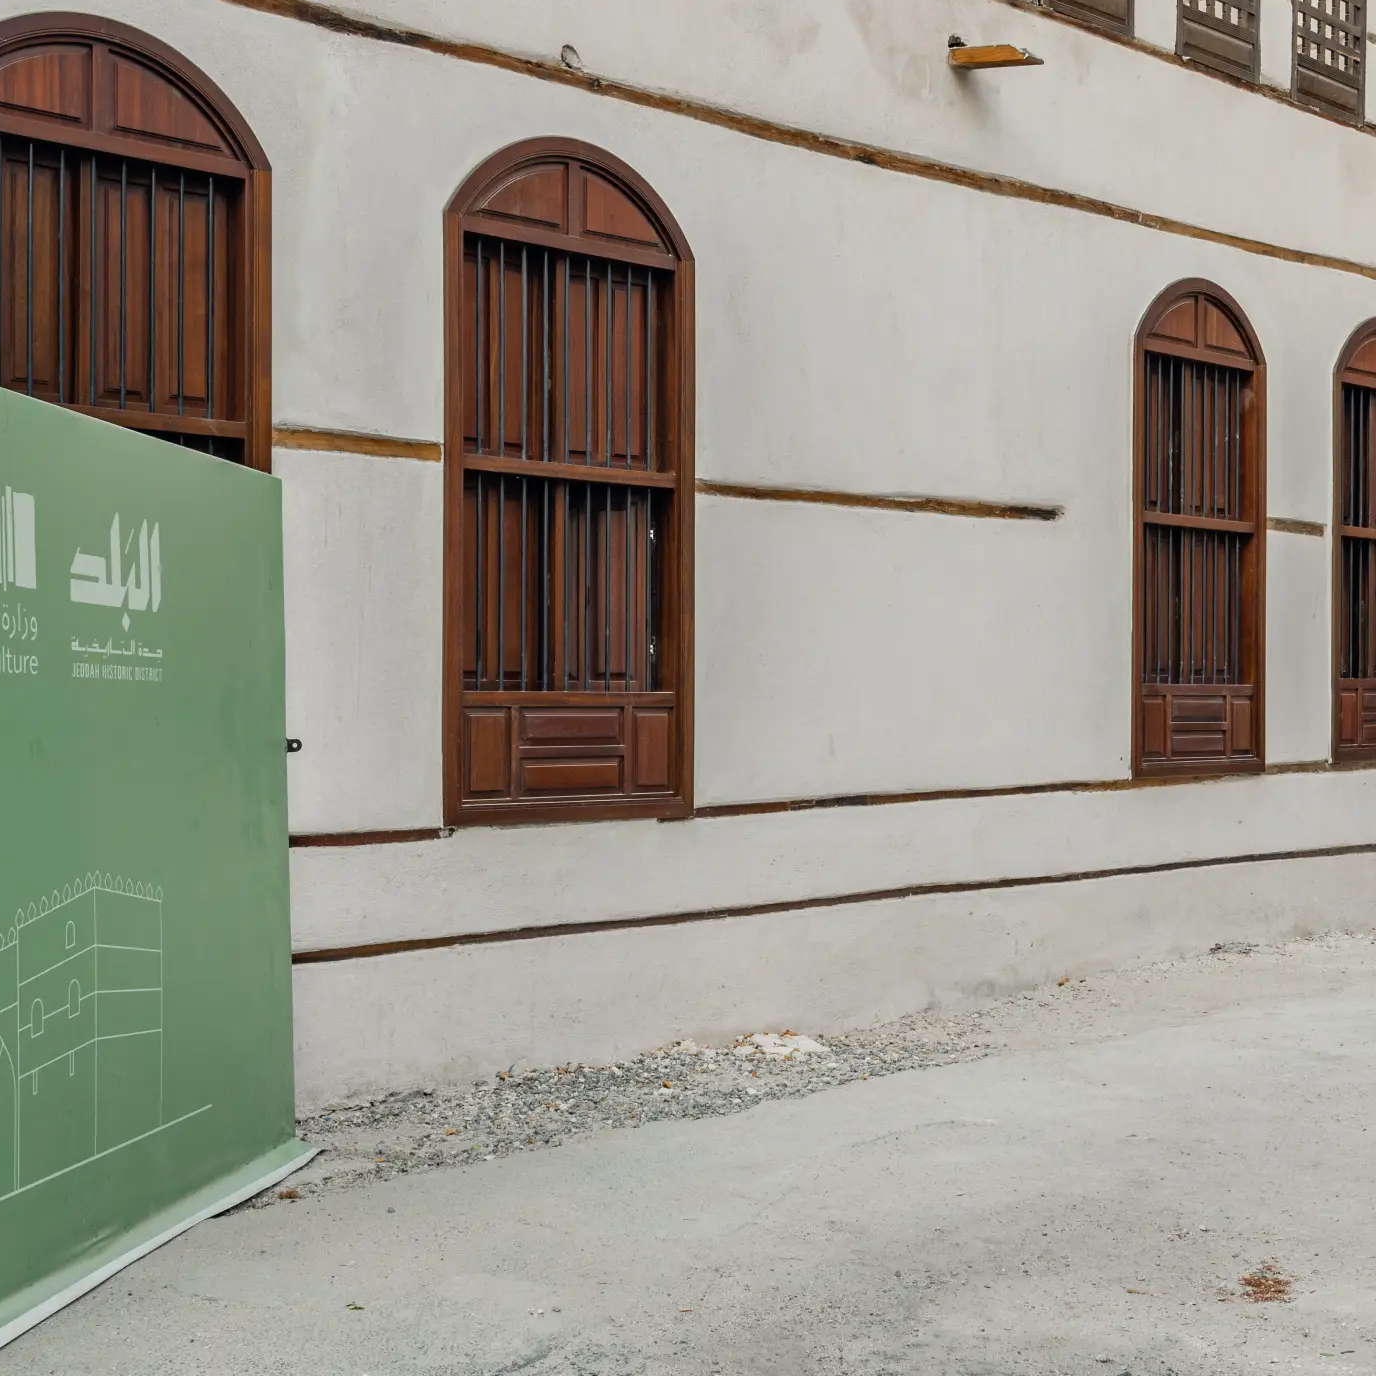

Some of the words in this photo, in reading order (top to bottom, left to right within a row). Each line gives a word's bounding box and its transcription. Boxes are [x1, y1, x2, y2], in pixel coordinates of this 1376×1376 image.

[1, 603, 38, 641] وزارة
[70, 636, 136, 660] التاريخية
[137, 642, 163, 664] جدة
[71, 662, 100, 679] JEDDAH
[101, 664, 133, 682] HISTORIC
[134, 666, 163, 682] DISTRICT
